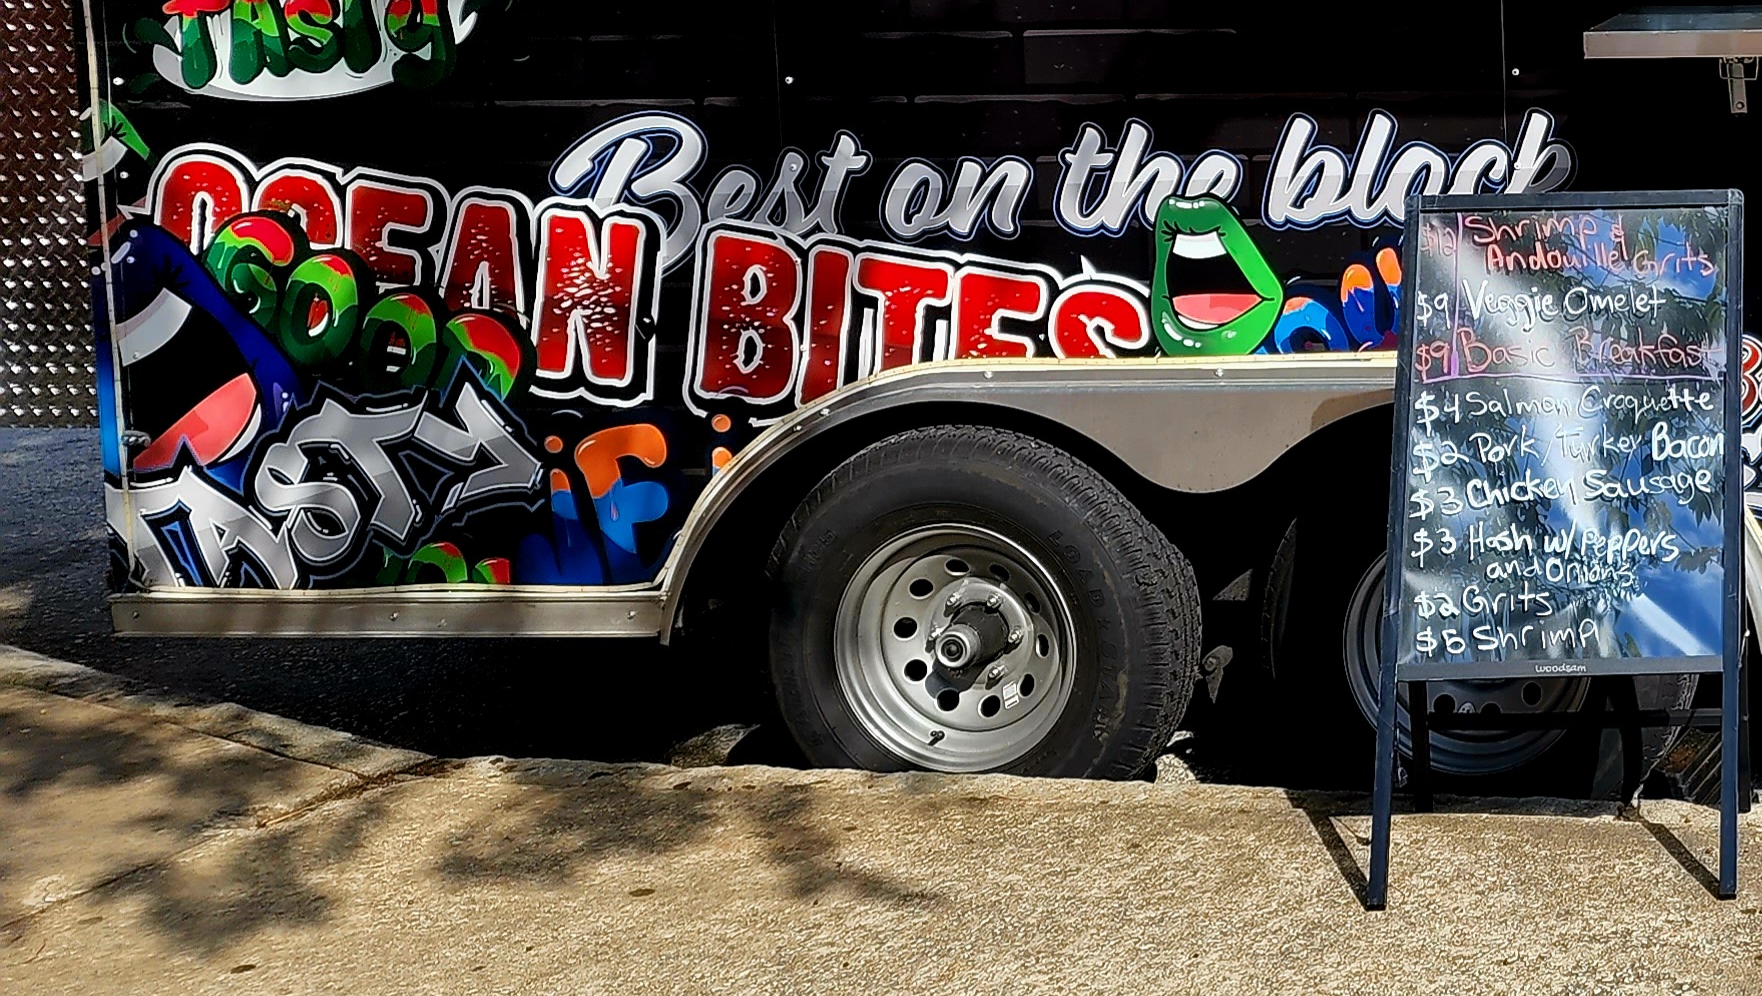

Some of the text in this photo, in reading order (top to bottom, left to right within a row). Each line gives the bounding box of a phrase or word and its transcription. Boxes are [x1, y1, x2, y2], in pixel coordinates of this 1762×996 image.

[550, 109, 1577, 273] Best on the block
[1464, 213, 1597, 245] Shrimp
[1632, 243, 1717, 277] Grits
[1415, 279, 1667, 333] $9 Veggie Omelet
[1415, 326, 1723, 382] $9 Basic Breakfast
[1414, 390, 1461, 437] $4
[1465, 388, 1571, 417] Salmon
[1412, 439, 1469, 483] $2
[1650, 422, 1726, 461] Bacon
[1409, 468, 1712, 521] $3 Chicken Sausage
[1411, 528, 1457, 568] $3
[1486, 555, 1634, 584] and Onions
[1413, 582, 1553, 621] $2 Grits
[1474, 617, 1601, 651] Shrimp
[1535, 663, 1587, 674] woodsam
